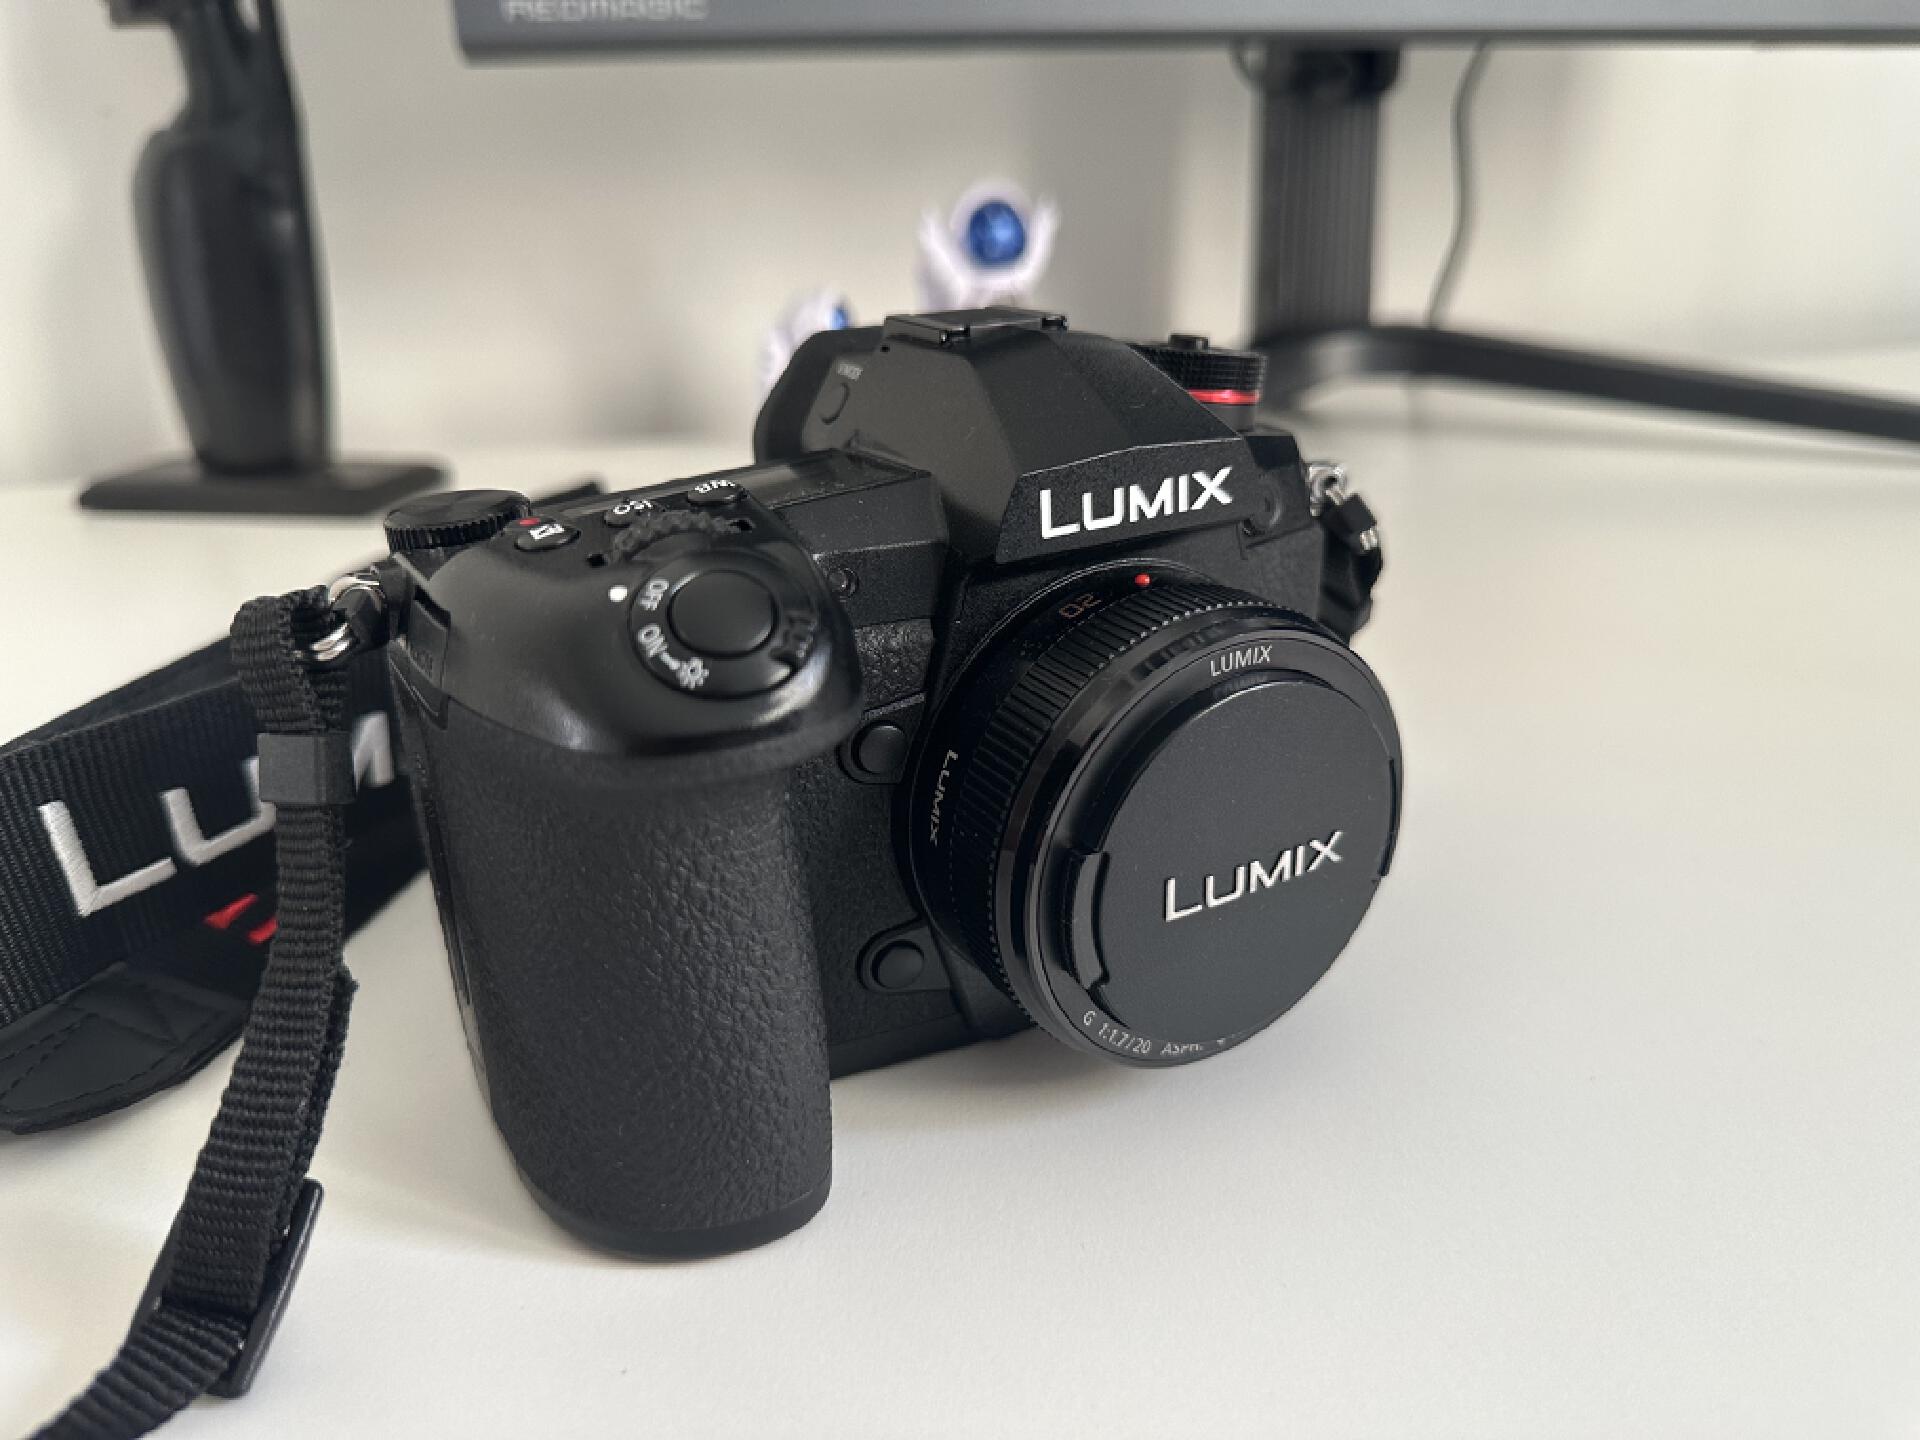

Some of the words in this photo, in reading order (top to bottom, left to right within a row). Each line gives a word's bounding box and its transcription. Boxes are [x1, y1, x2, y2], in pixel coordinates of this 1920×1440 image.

[1040, 465, 1233, 539] LUMIX
[638, 578, 670, 611] OFF
[636, 623, 668, 657] ON
[1210, 645, 1273, 676] LUMIX
[929, 749, 959, 848] LUMIX
[1164, 829, 1346, 923] LUMIX
[1083, 1010, 1096, 1026] G
